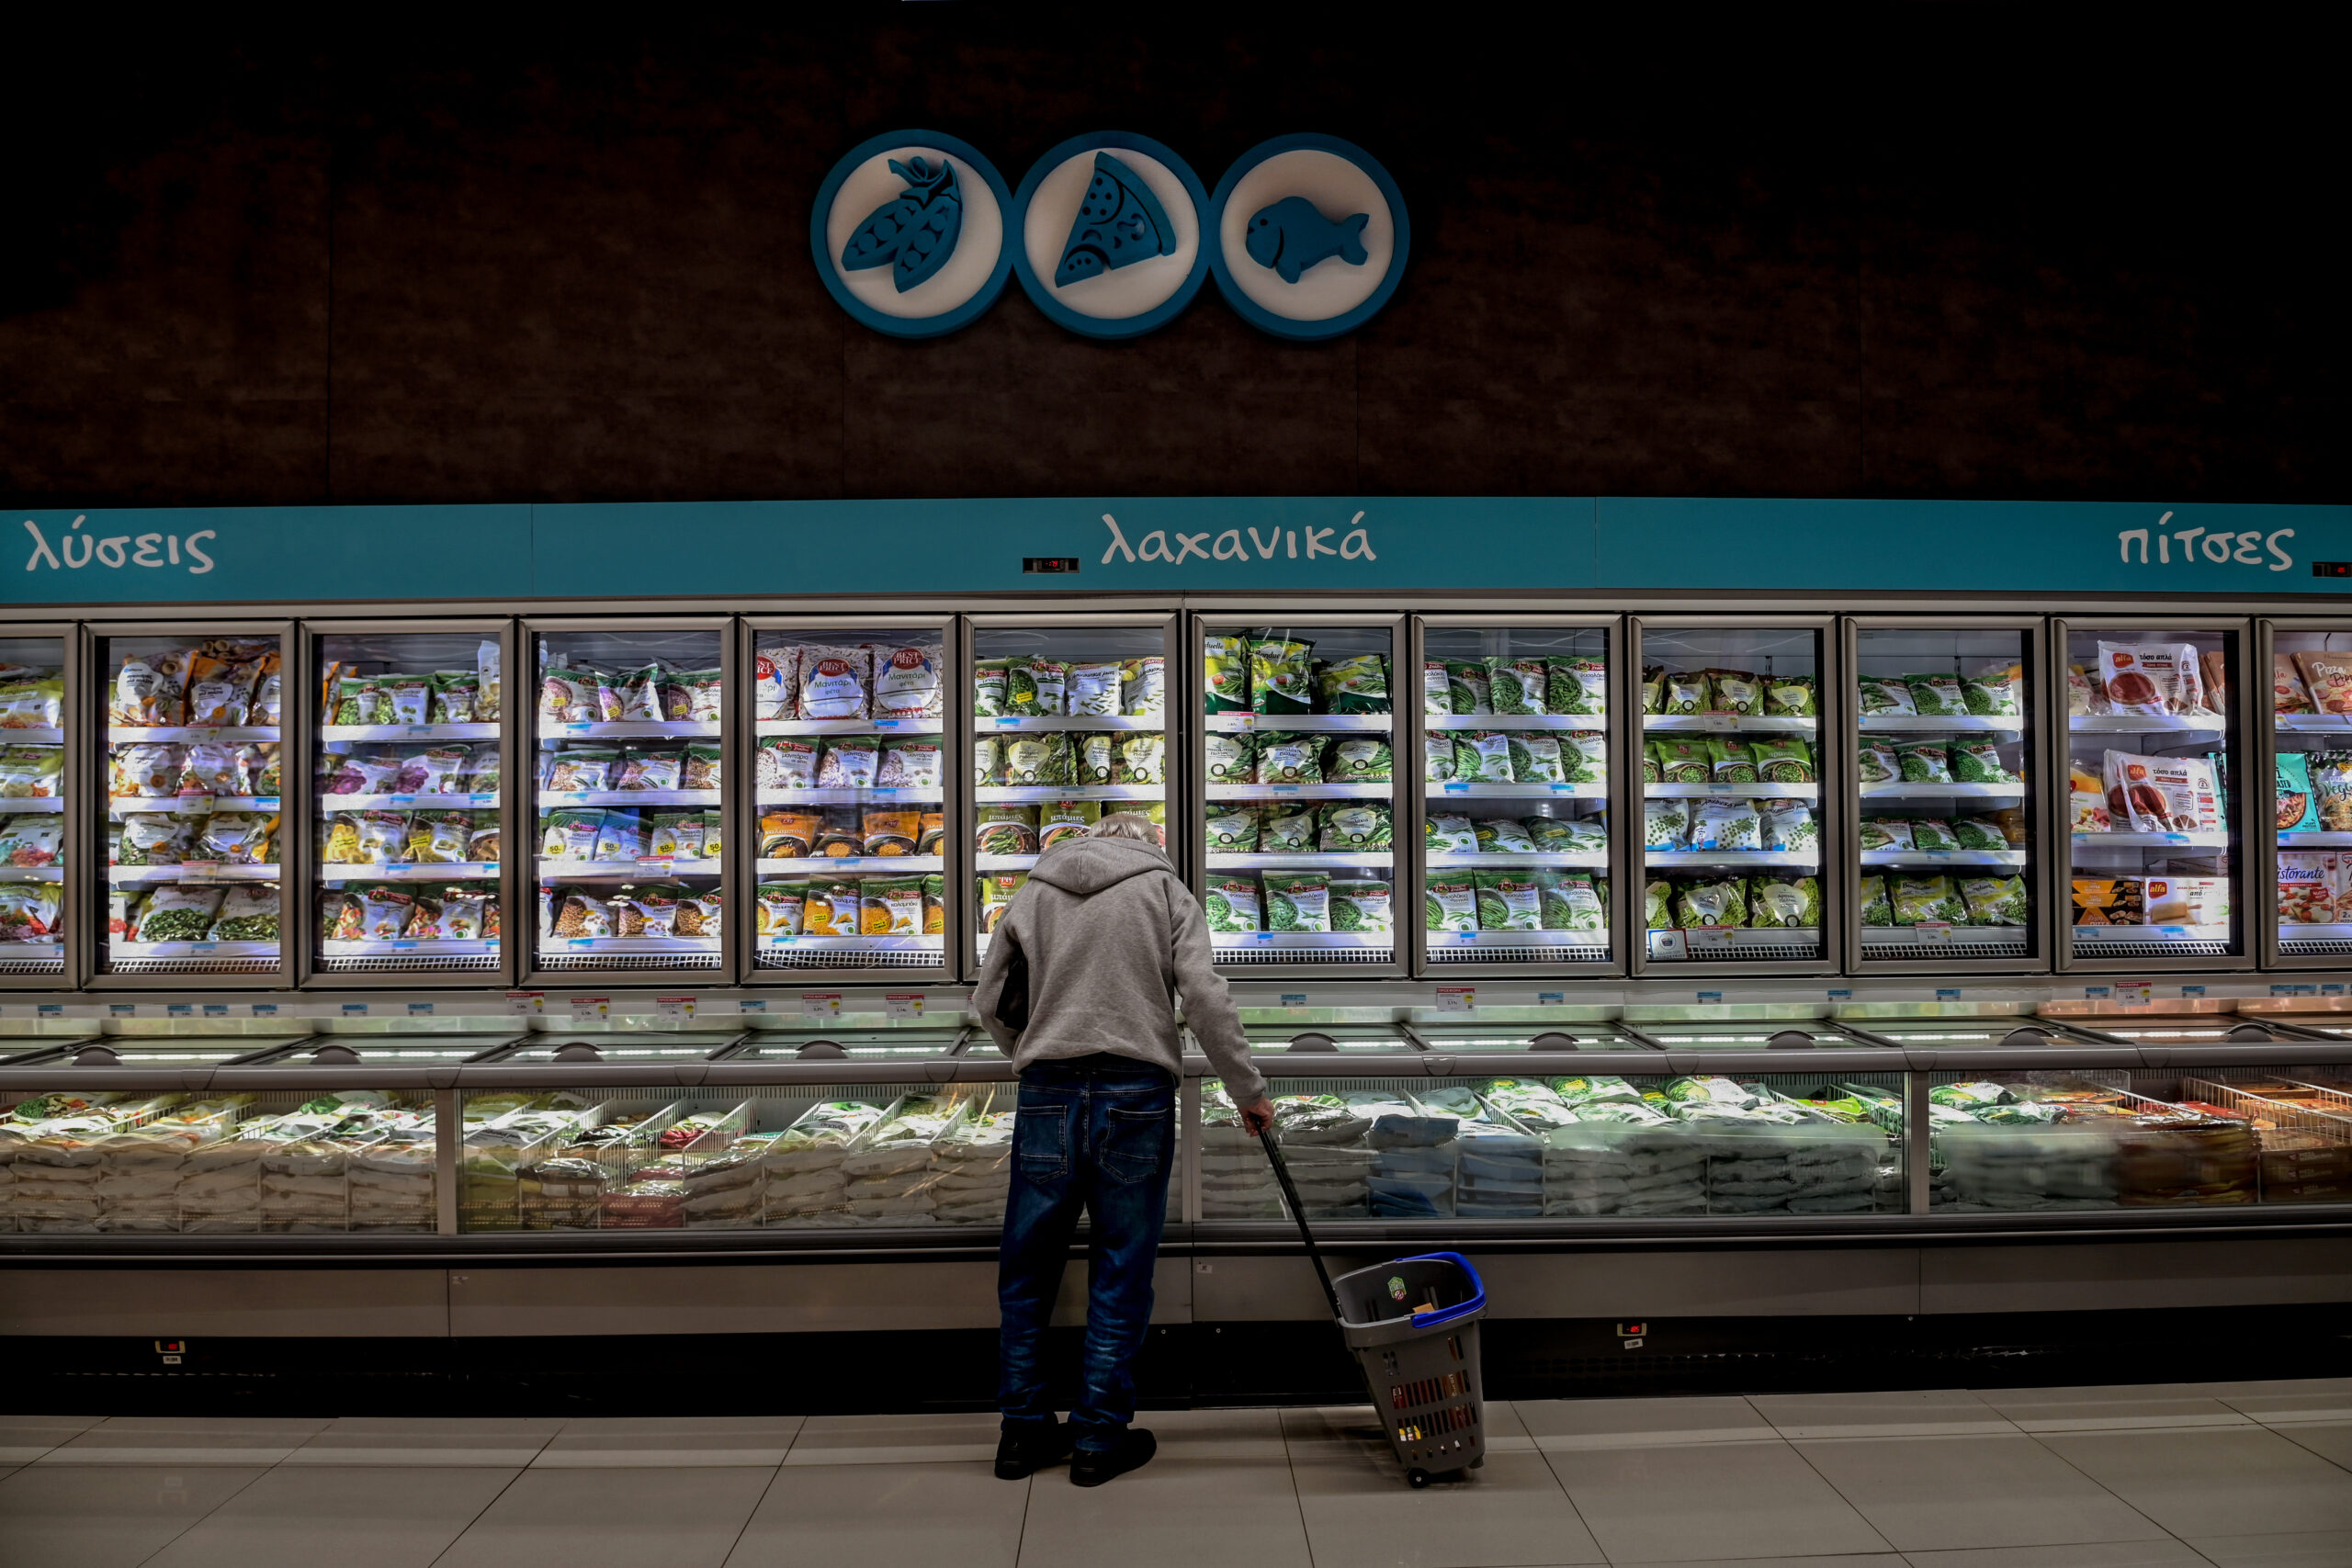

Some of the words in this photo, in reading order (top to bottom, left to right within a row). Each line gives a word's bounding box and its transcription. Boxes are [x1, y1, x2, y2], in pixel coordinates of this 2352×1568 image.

[24, 514, 216, 574] λύσεις
[1101, 511, 1377, 565] λαχανικά
[2119, 511, 2295, 571] πίτσες
[2312, 662, 2346, 678] Pizza
[2277, 780, 2291, 788] ASED
[1050, 814, 1085, 823] μπάμιες
[2278, 866, 2324, 880] istorante
[2150, 883, 2165, 892] alfa
